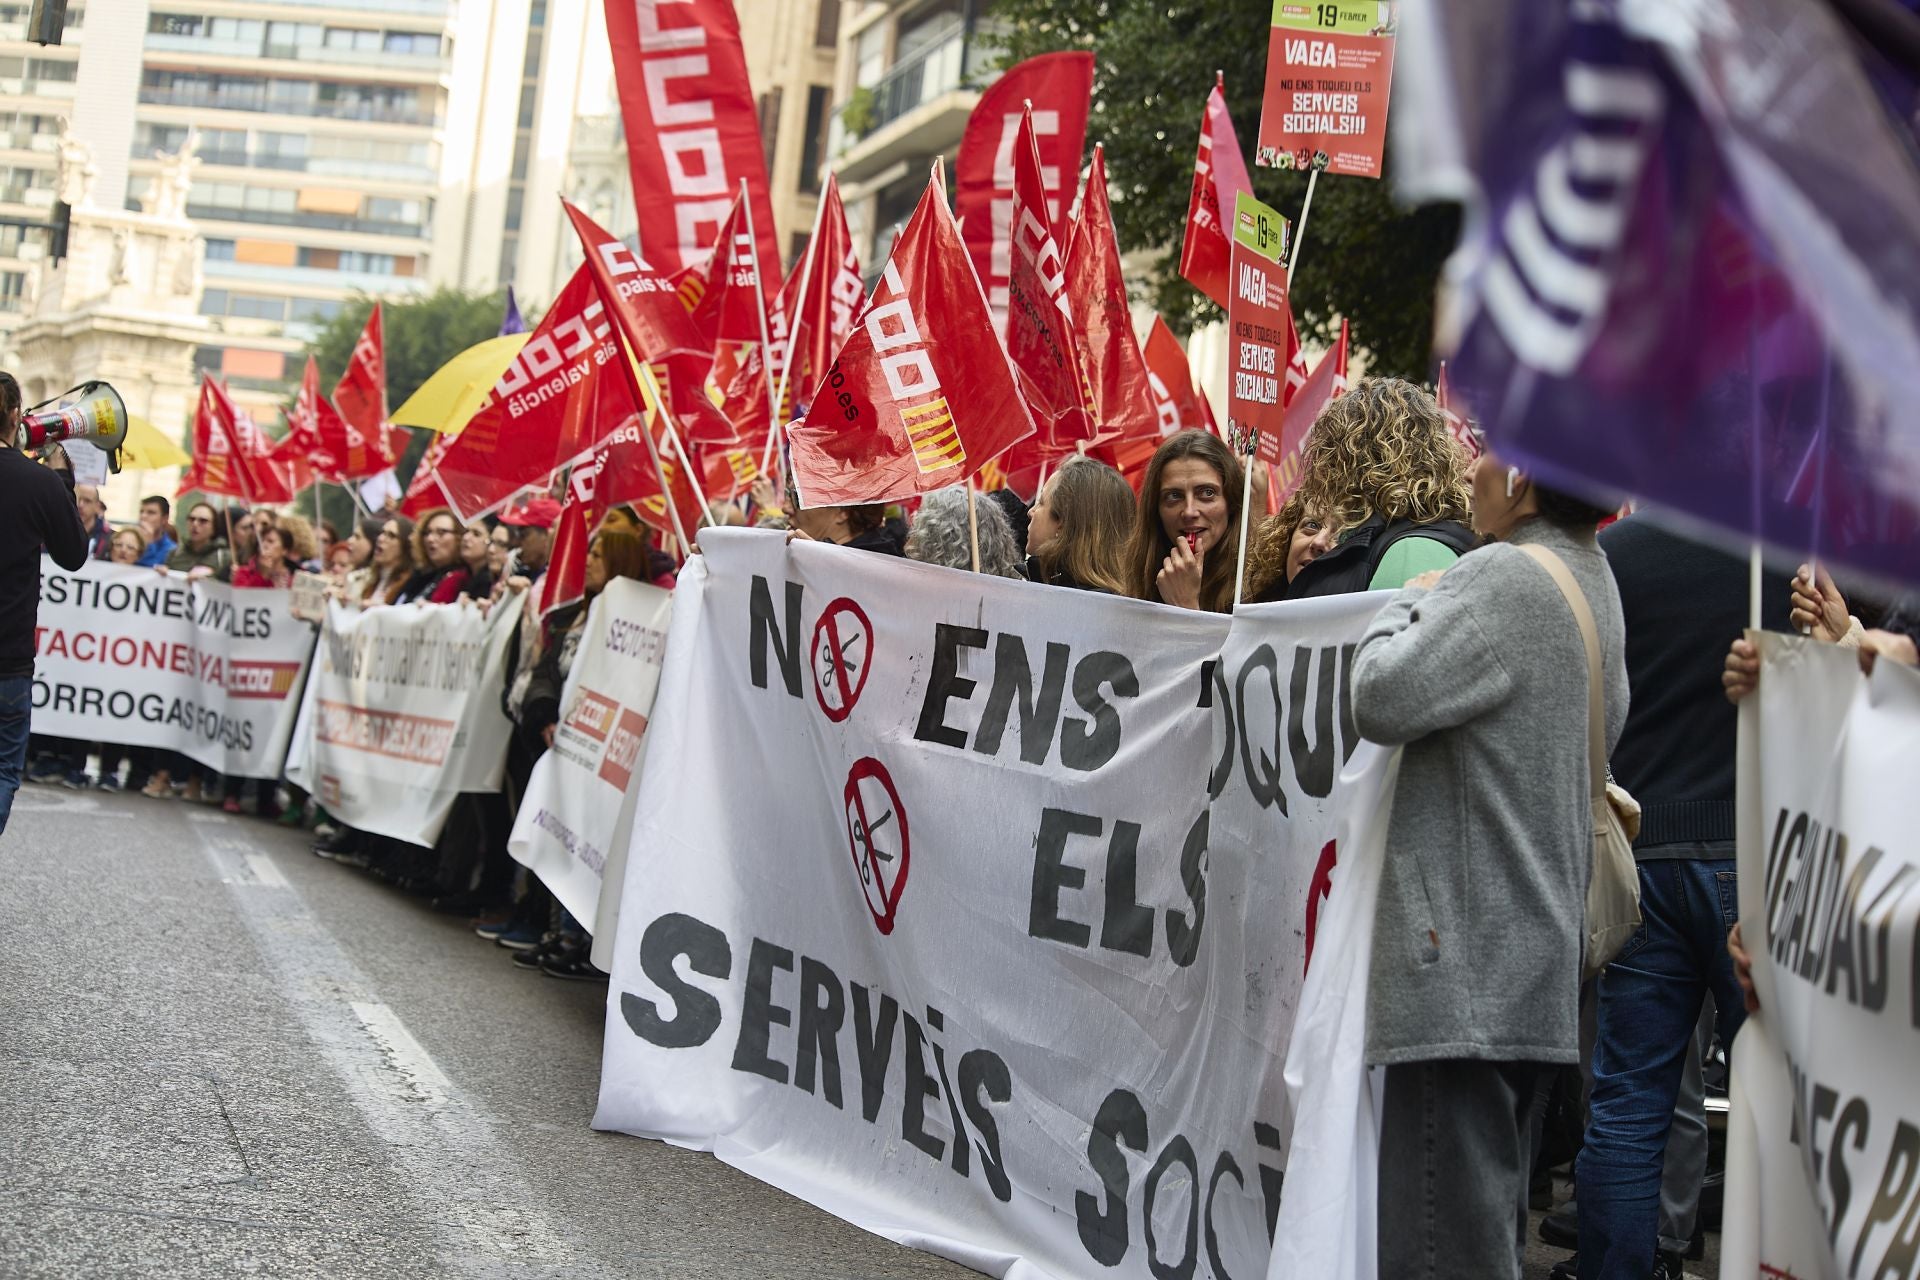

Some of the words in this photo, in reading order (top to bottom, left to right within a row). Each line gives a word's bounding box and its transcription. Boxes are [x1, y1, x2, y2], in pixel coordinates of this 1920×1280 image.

[1317, 4, 1337, 27] 19
[1340, 11, 1367, 22] FEBRER
[1285, 38, 1336, 68] VAGA
[1281, 79, 1293, 90] NO
[1296, 80, 1313, 90] ENS
[1317, 80, 1351, 92] TOQUEU
[1354, 81, 1371, 92] ELS
[1292, 92, 1358, 113] SERVEIS
[1283, 113, 1366, 135] SOCIALS!!!
[1257, 213, 1267, 249] 19
[1239, 261, 1266, 308] VAGA
[1235, 321, 1242, 336] NO
[1243, 323, 1253, 339] ENS
[1273, 329, 1281, 346] ELS
[1240, 341, 1276, 375] SERVEIS
[1235, 371, 1278, 405] SOCIALS!!!
[913, 621, 1140, 773] ENS
[1028, 806, 1210, 967] ELS
